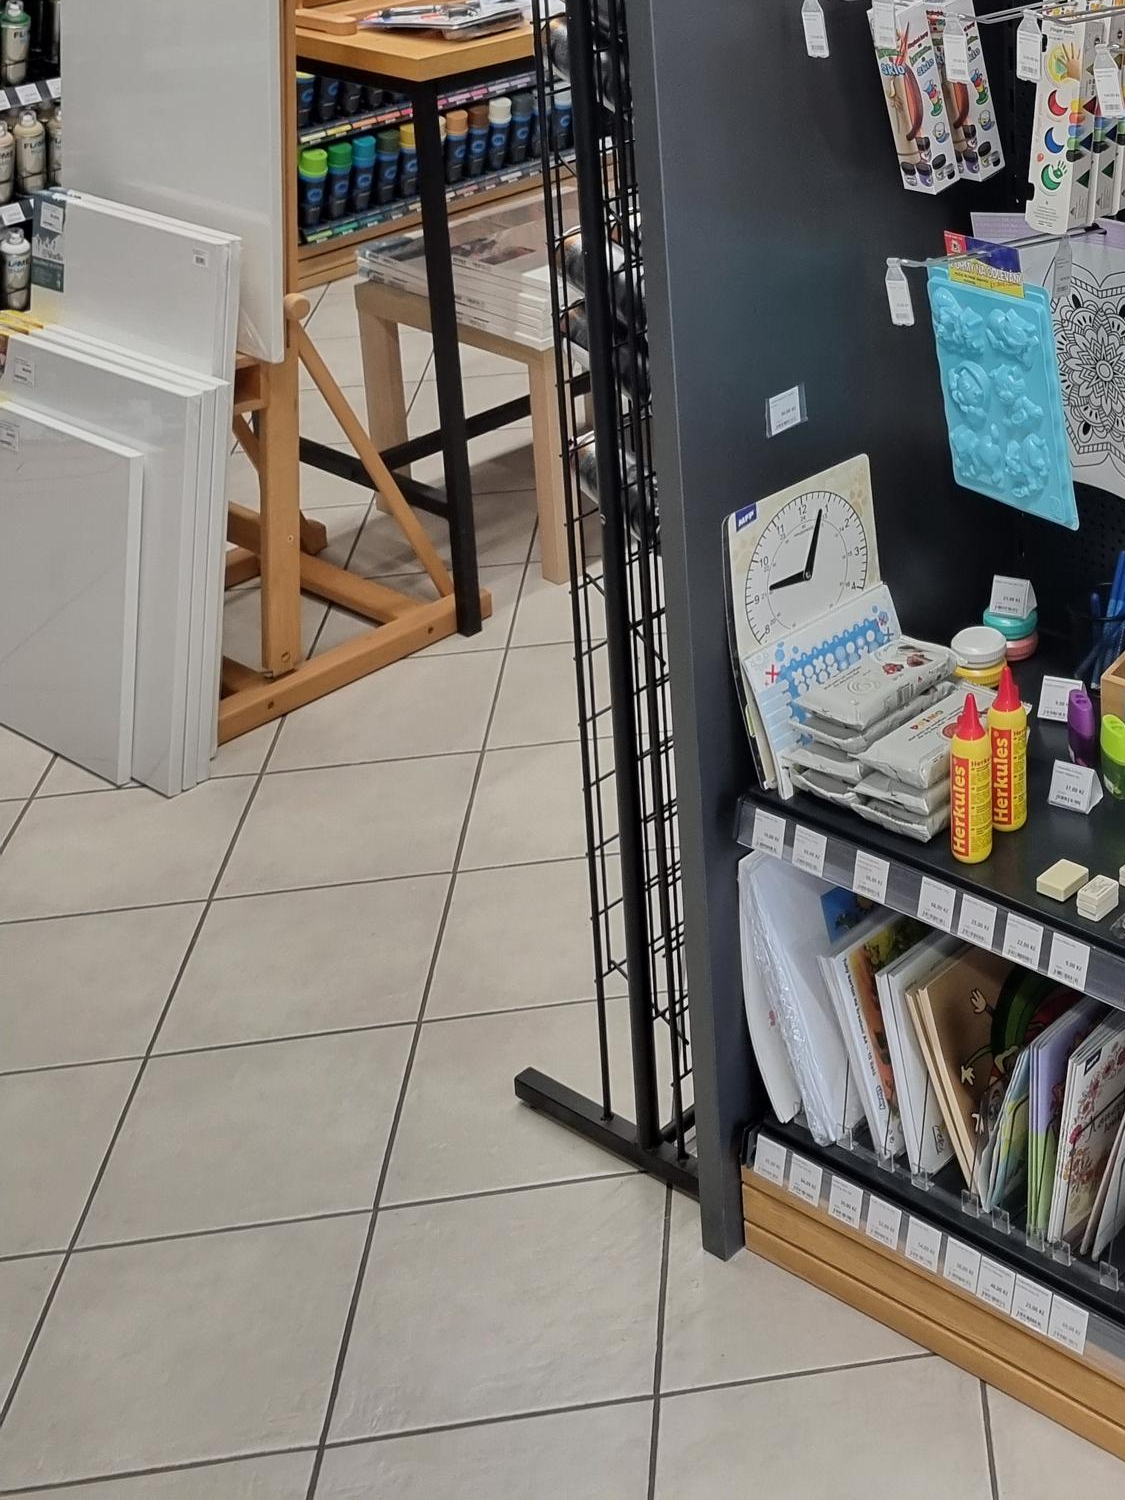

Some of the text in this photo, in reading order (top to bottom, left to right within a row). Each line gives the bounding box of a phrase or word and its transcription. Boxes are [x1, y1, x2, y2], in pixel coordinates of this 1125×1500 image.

[880, 61, 906, 76] Sklo
[738, 508, 755, 528] MFP
[798, 504, 808, 516] 12
[759, 555, 769, 568] 10
[993, 736, 1009, 823] Herkules
[952, 765, 966, 854] Herkules
